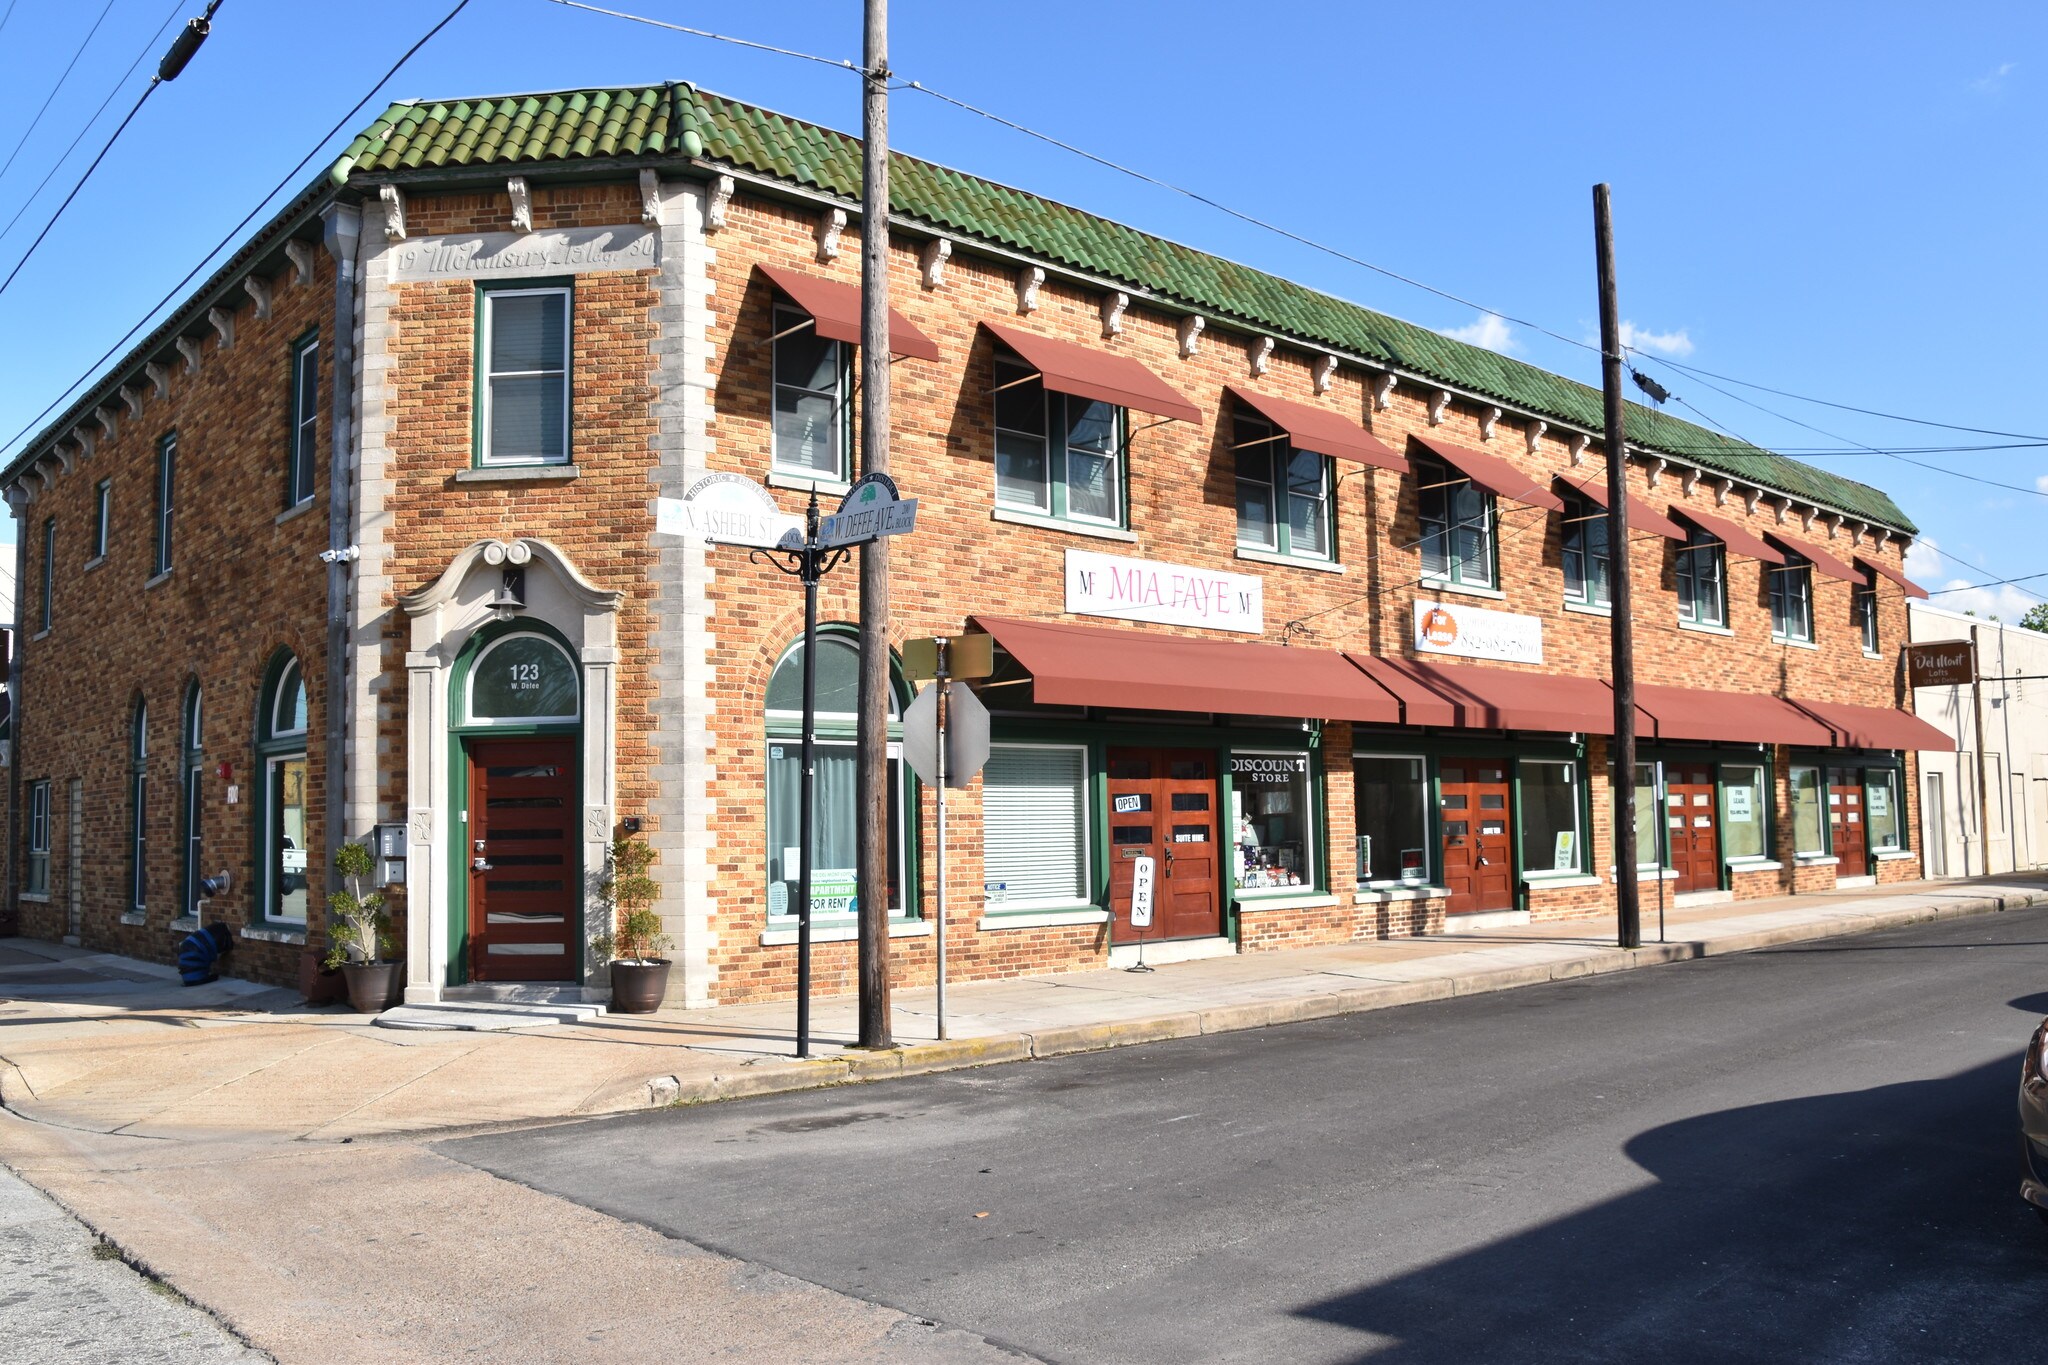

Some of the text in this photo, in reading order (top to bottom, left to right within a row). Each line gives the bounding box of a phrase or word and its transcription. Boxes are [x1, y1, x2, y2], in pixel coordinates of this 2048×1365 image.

[398, 251, 418, 271] 19
[688, 474, 777, 512] HISTORIC DISTRICT
[874, 473, 898, 497] DISTRICT
[685, 505, 699, 531] N.
[759, 515, 778, 541] ST.
[834, 505, 895, 541] W. DEFEE AVE.
[895, 516, 913, 529] BLOCK
[1107, 565, 1231, 618] MIA FAYE
[1914, 653, 1967, 669] Del Mont
[510, 663, 539, 681] 123
[1929, 668, 1948, 677] Lofts
[511, 682, 540, 690] W. Defee
[1231, 758, 1305, 772] DISCOUNT
[1252, 773, 1289, 782] STORE
[1118, 797, 1139, 810] OPEN
[1136, 863, 1149, 918] OPEN
[828, 897, 848, 909] RENT
